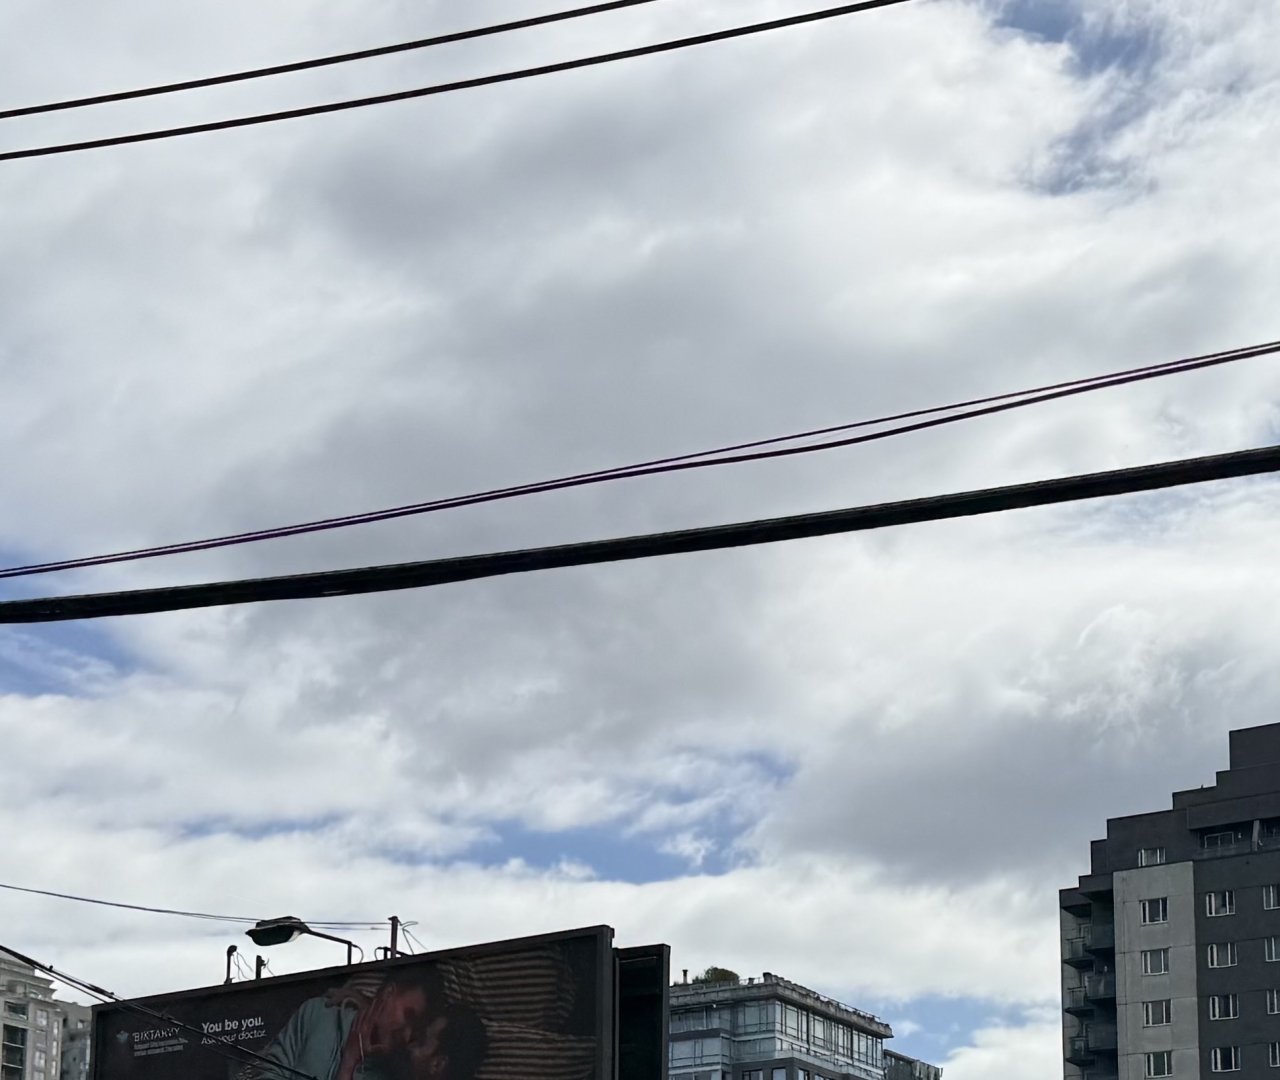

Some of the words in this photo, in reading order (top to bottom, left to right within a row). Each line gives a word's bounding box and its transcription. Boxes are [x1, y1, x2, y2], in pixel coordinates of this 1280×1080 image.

[201, 1022, 221, 1033] You
[225, 1019, 239, 1030] be
[241, 1017, 264, 1031] you.
